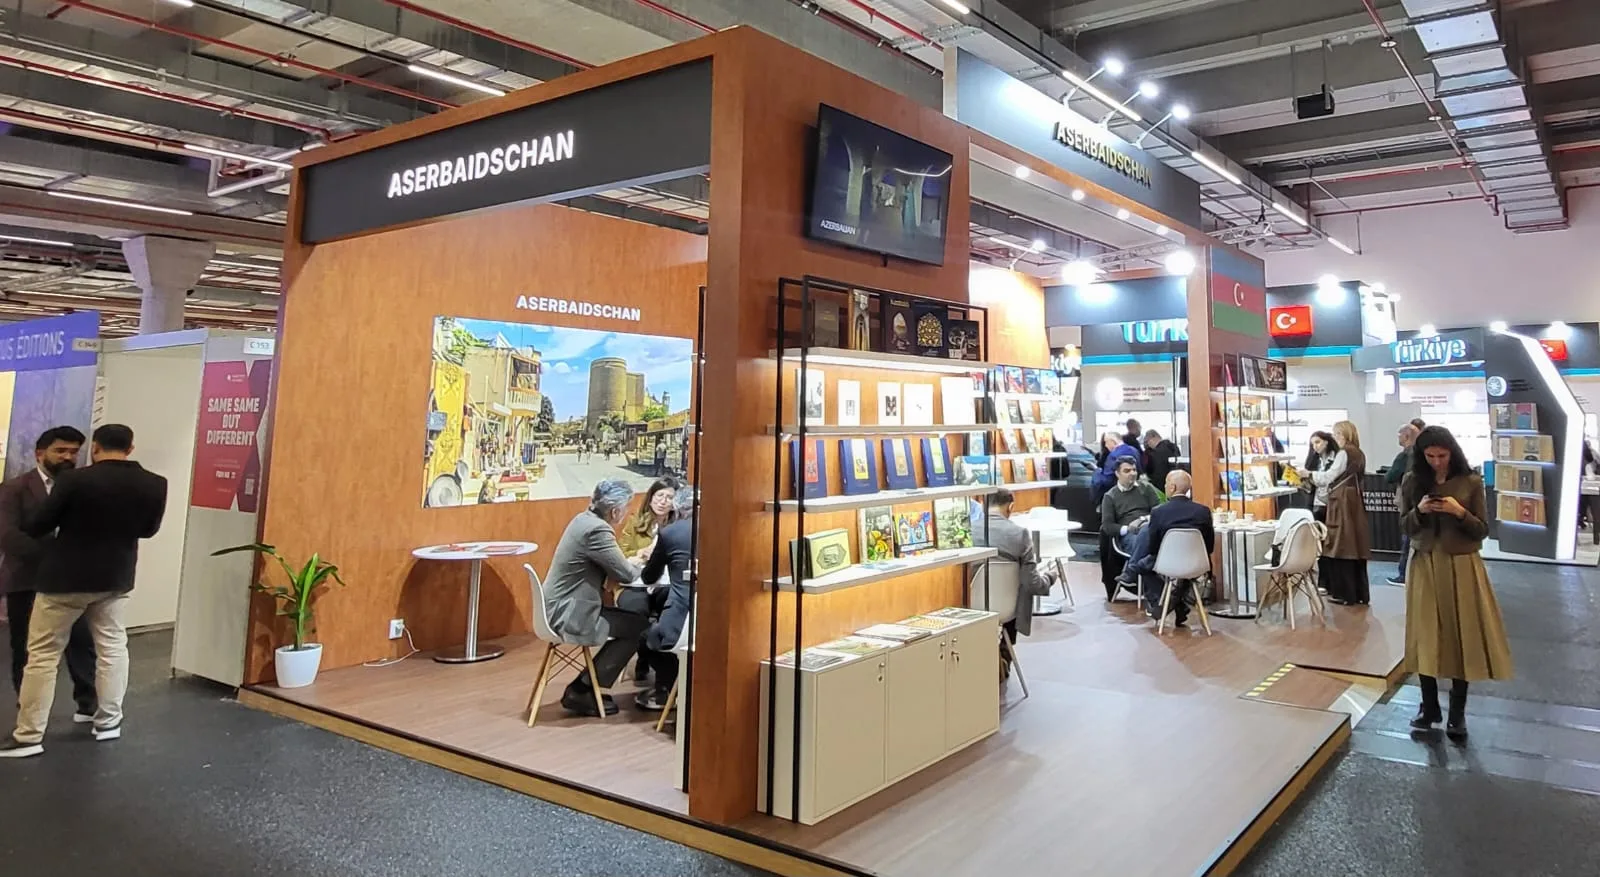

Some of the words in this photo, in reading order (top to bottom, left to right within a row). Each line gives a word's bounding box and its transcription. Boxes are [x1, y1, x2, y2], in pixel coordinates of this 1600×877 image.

[387, 130, 574, 198] ASERBAIDSCHAN
[1053, 122, 1152, 187] ASERBAIDSCHAN
[516, 295, 641, 321] ASERBAIDSCHAN
[16, 329, 65, 360] ÉDITIONS
[1389, 336, 1466, 365] Türkiye
[207, 397, 233, 413] SAME
[233, 397, 260, 413] SAME
[222, 414, 240, 429] BUT
[206, 430, 255, 447] DIFFERENT
